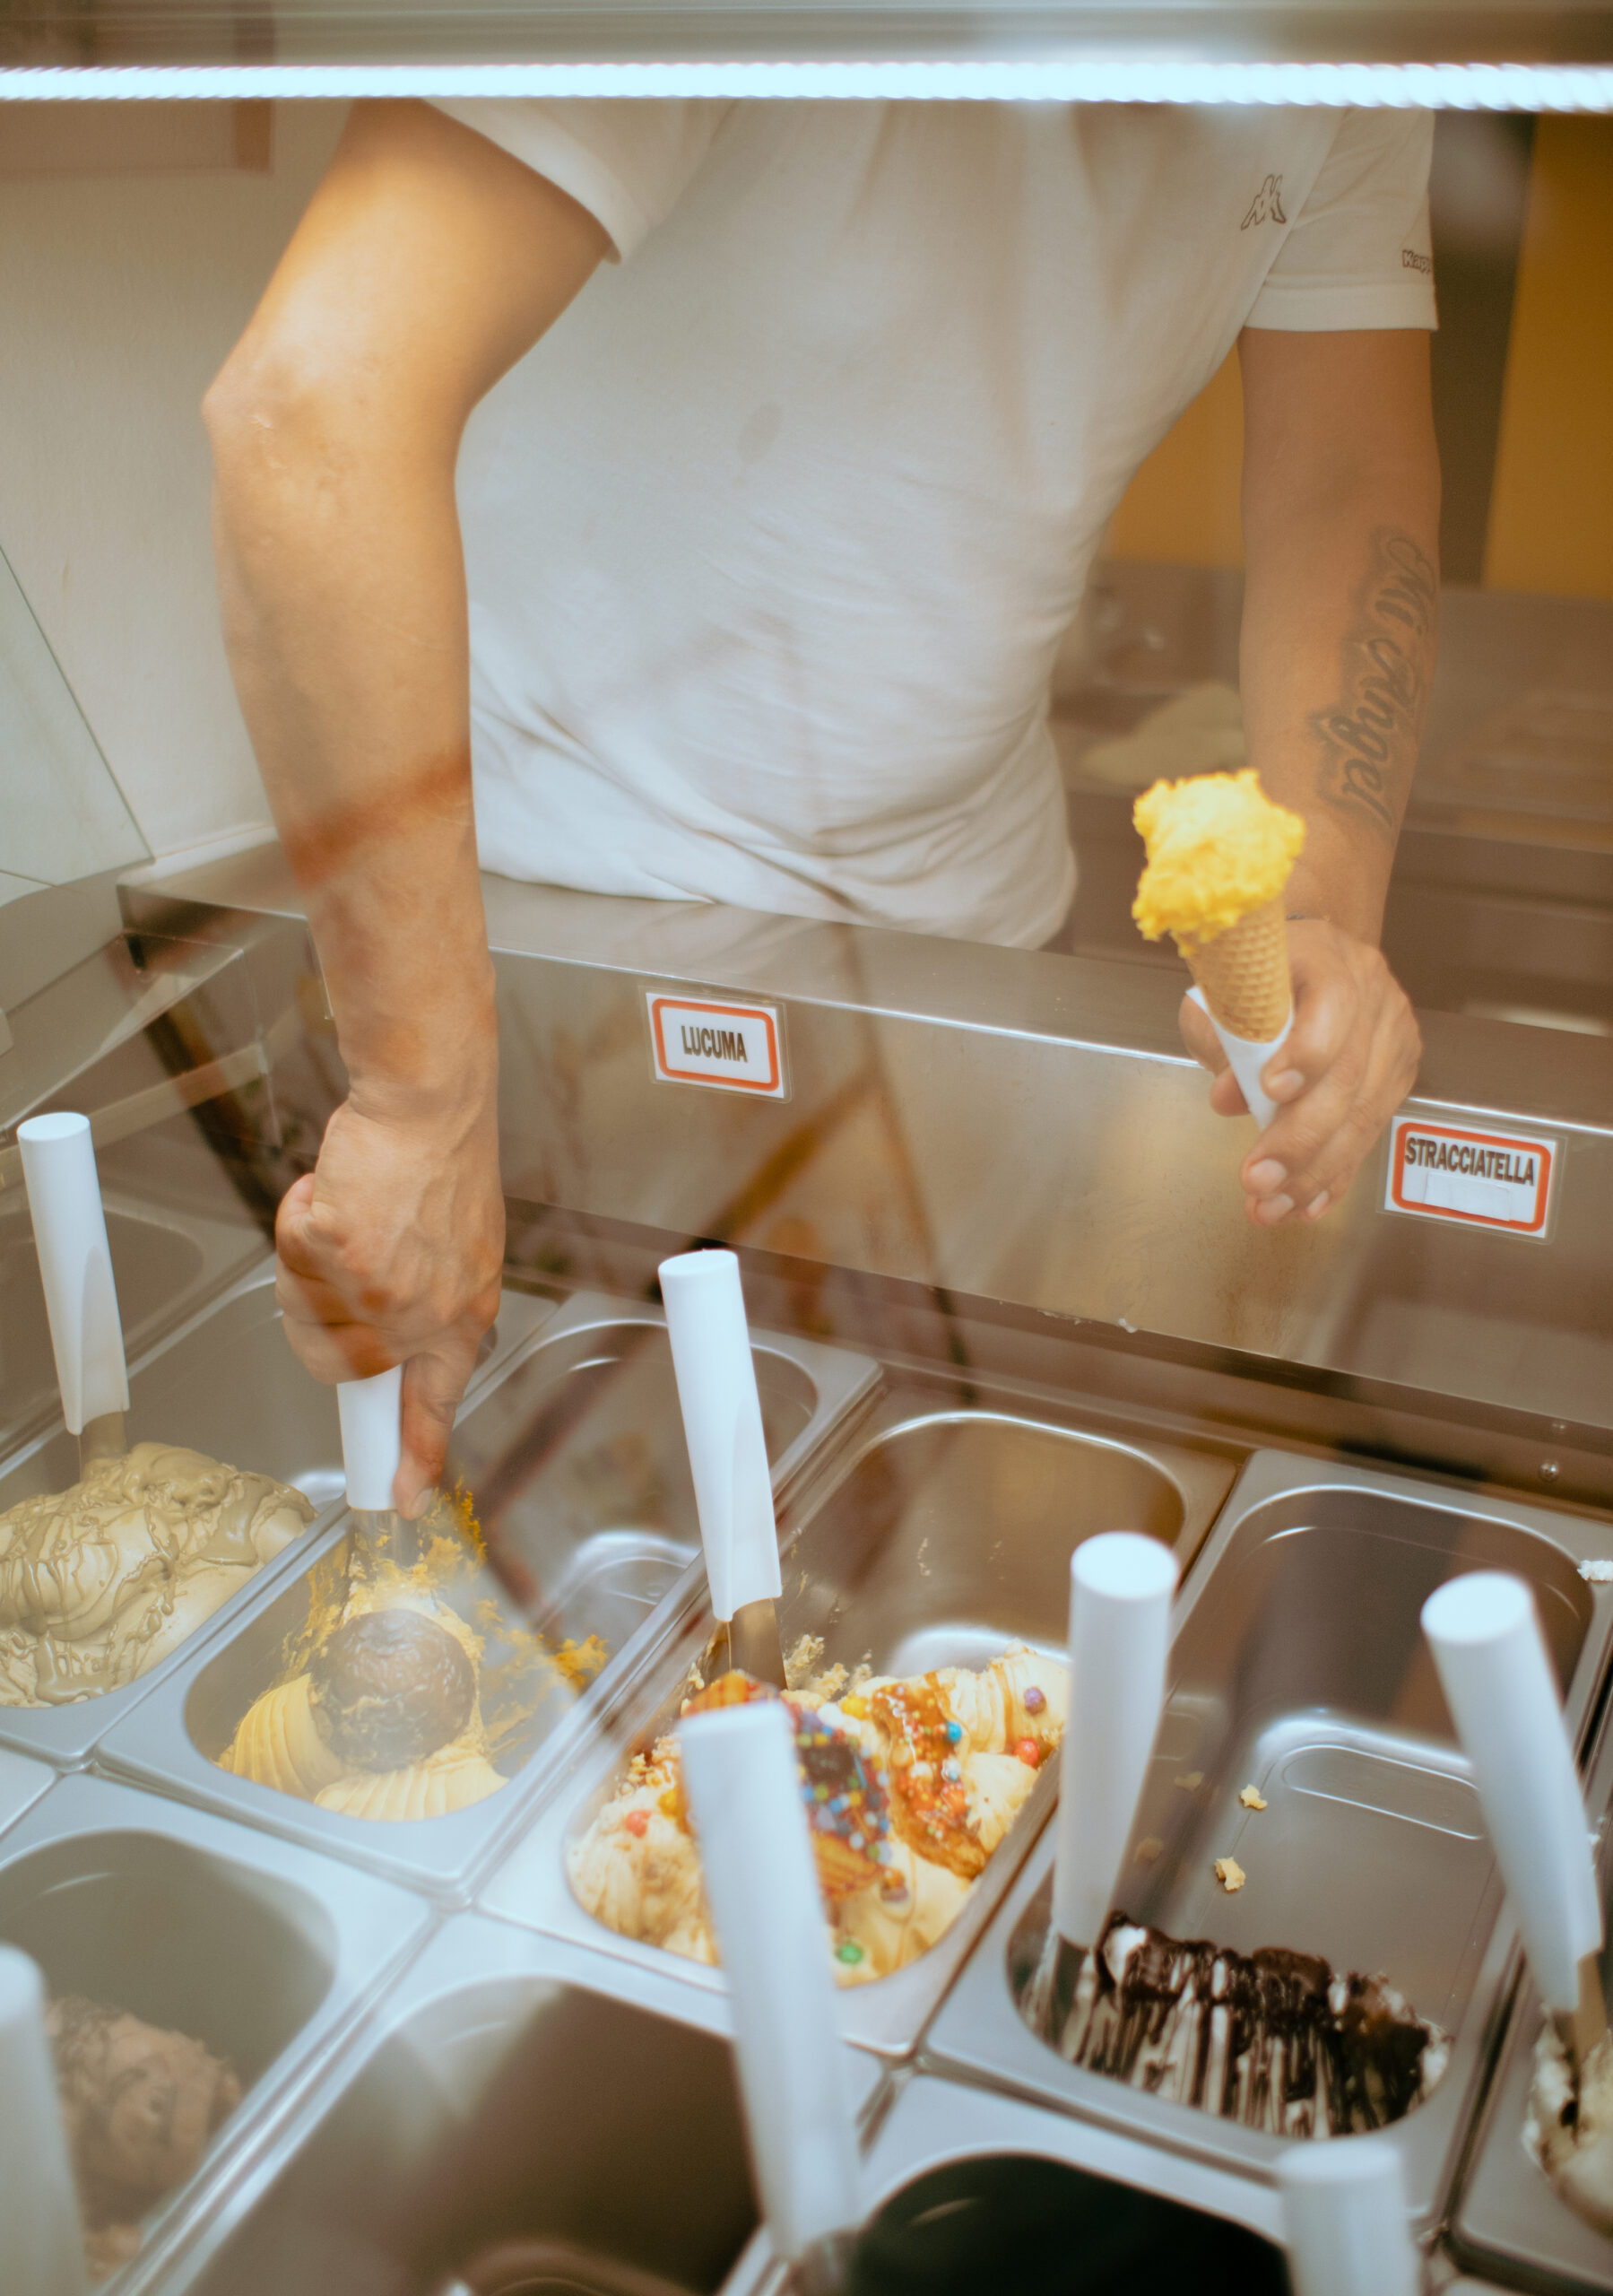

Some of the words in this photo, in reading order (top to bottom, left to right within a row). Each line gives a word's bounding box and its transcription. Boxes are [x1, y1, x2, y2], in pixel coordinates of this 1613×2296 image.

[1375, 537, 1435, 636] Mi
[1329, 637, 1419, 827] Angel
[681, 1025, 748, 1063] LUCUMA
[1404, 1137, 1534, 1186] STRACCIATELLA
